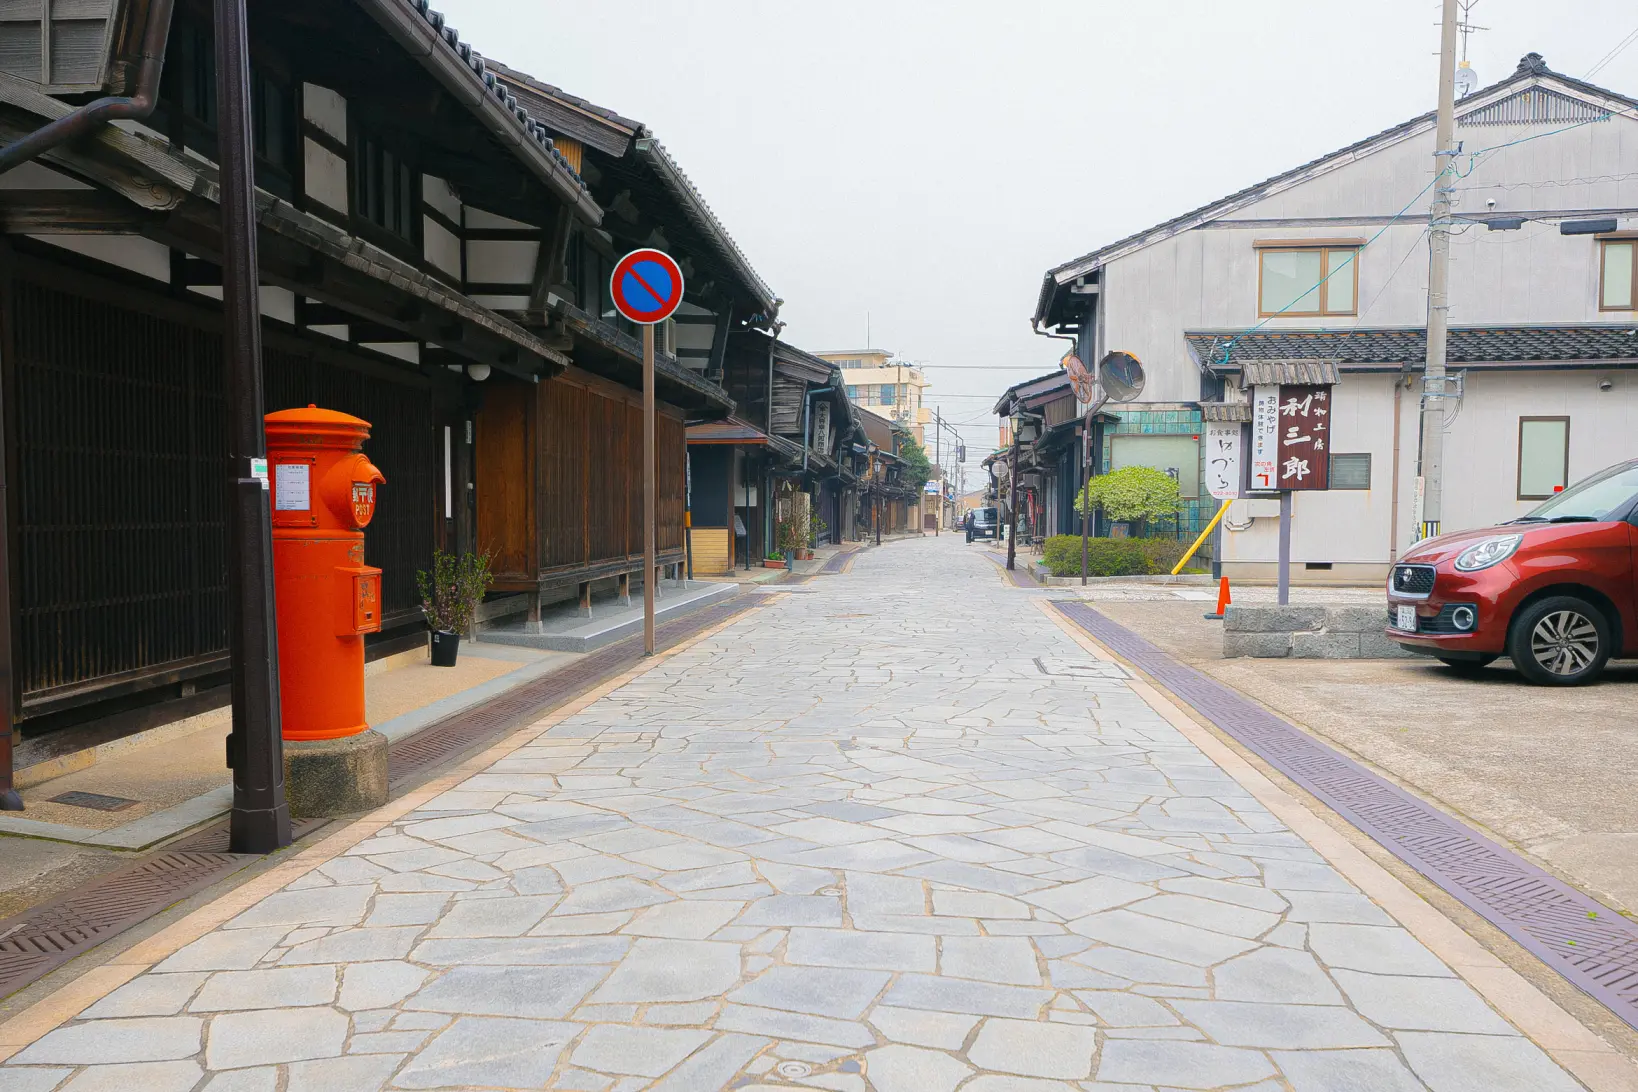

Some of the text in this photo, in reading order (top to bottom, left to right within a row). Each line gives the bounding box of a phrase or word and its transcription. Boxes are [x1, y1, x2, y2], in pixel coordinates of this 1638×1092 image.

[1266, 396, 1276, 434] おみやげ
[1279, 394, 1313, 480] 利三郎
[355, 504, 370, 516] POST
